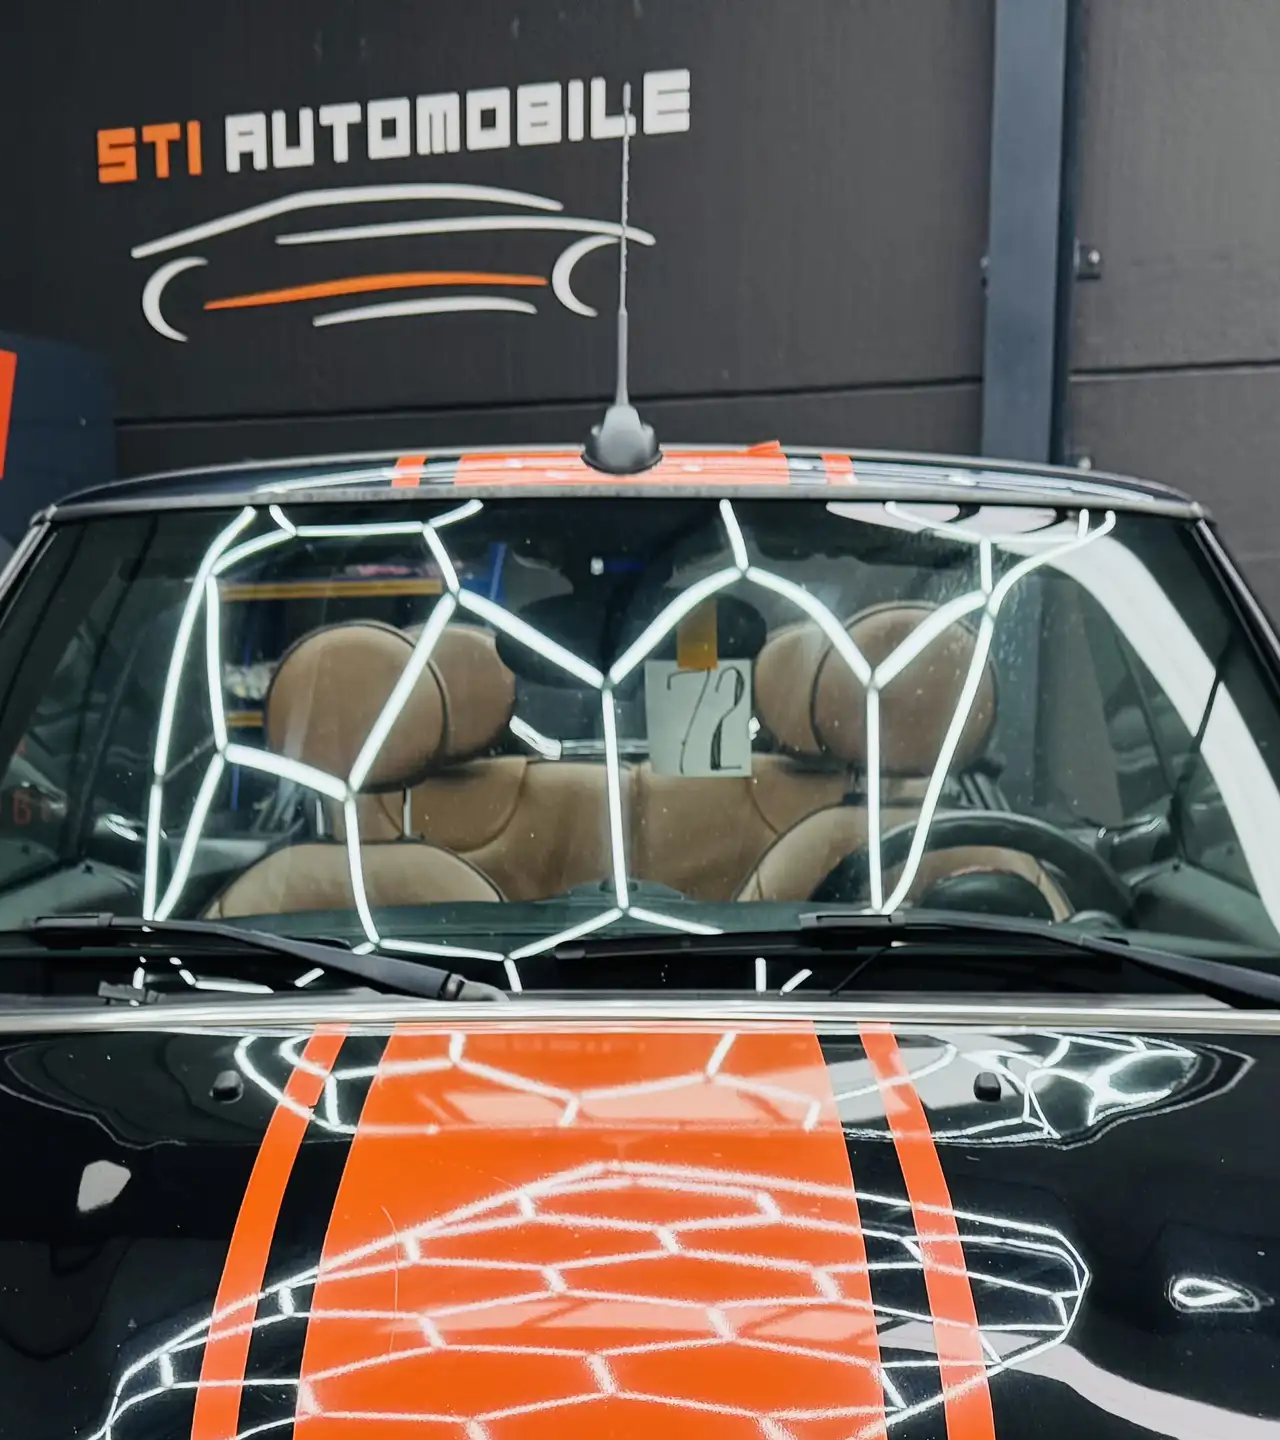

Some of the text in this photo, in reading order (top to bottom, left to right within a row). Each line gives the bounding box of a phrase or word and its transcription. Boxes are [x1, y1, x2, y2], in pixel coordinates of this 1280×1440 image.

[96, 68, 692, 185] STI AUTOMOBILE
[666, 665, 746, 775] 72
